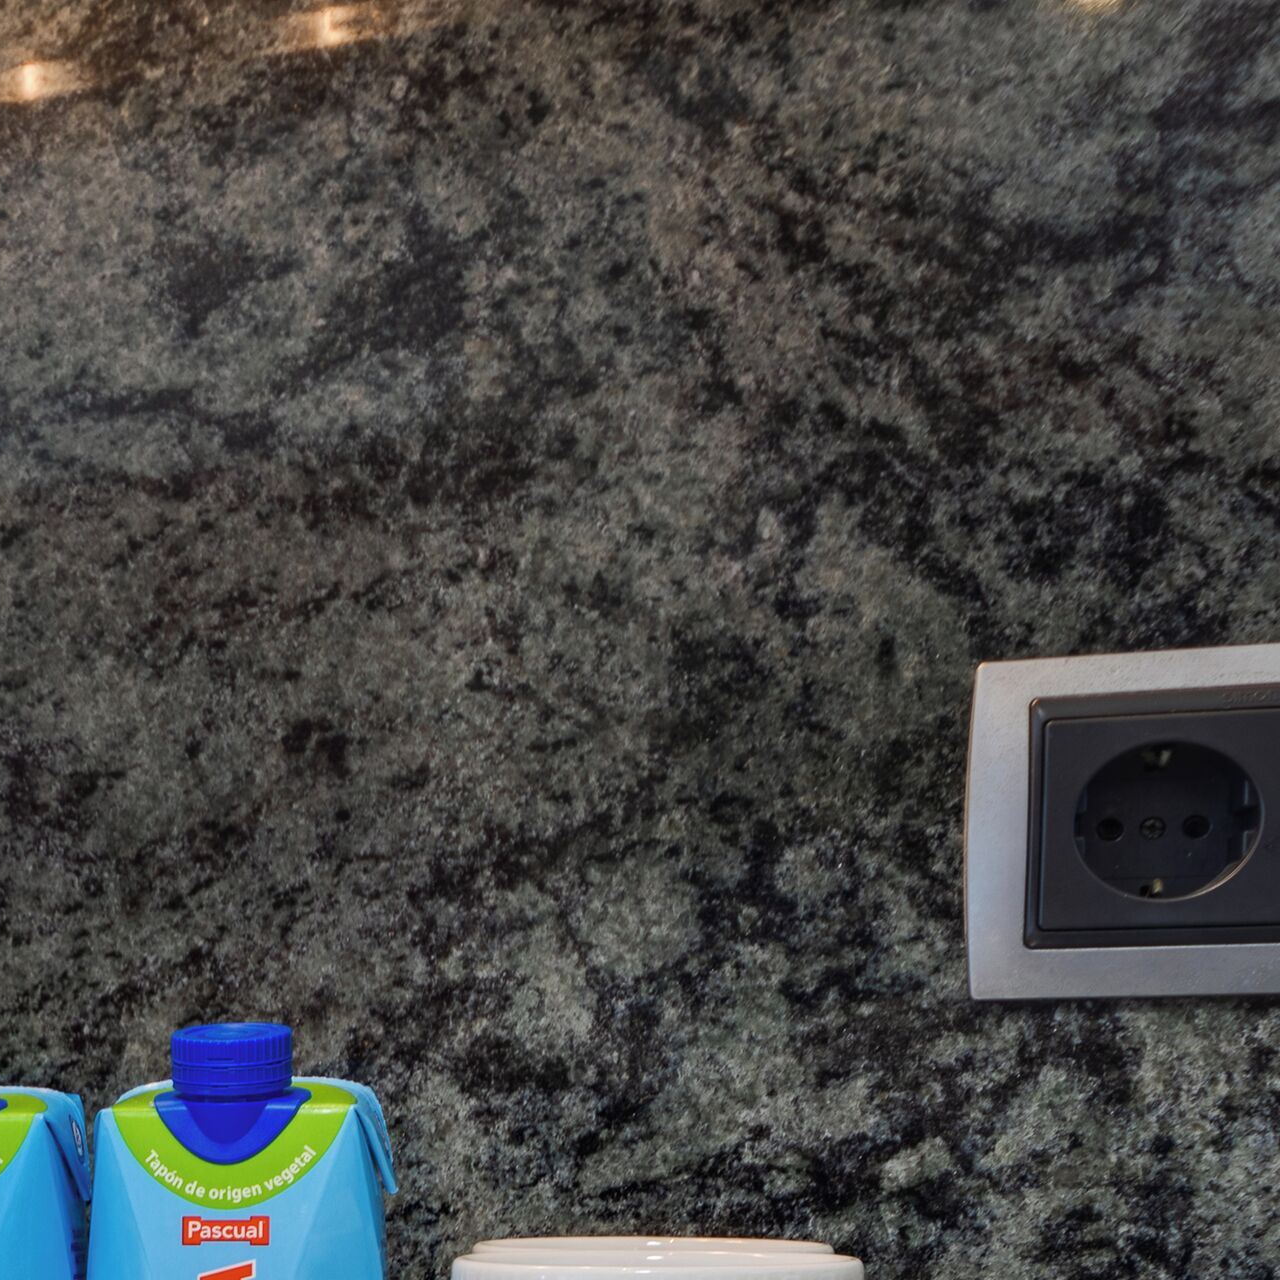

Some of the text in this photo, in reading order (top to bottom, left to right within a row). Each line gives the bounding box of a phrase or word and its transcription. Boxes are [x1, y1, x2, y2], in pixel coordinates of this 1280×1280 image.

[144, 1144, 318, 1204] Tapón de origen vegetal
[187, 1220, 264, 1240] Pascual
